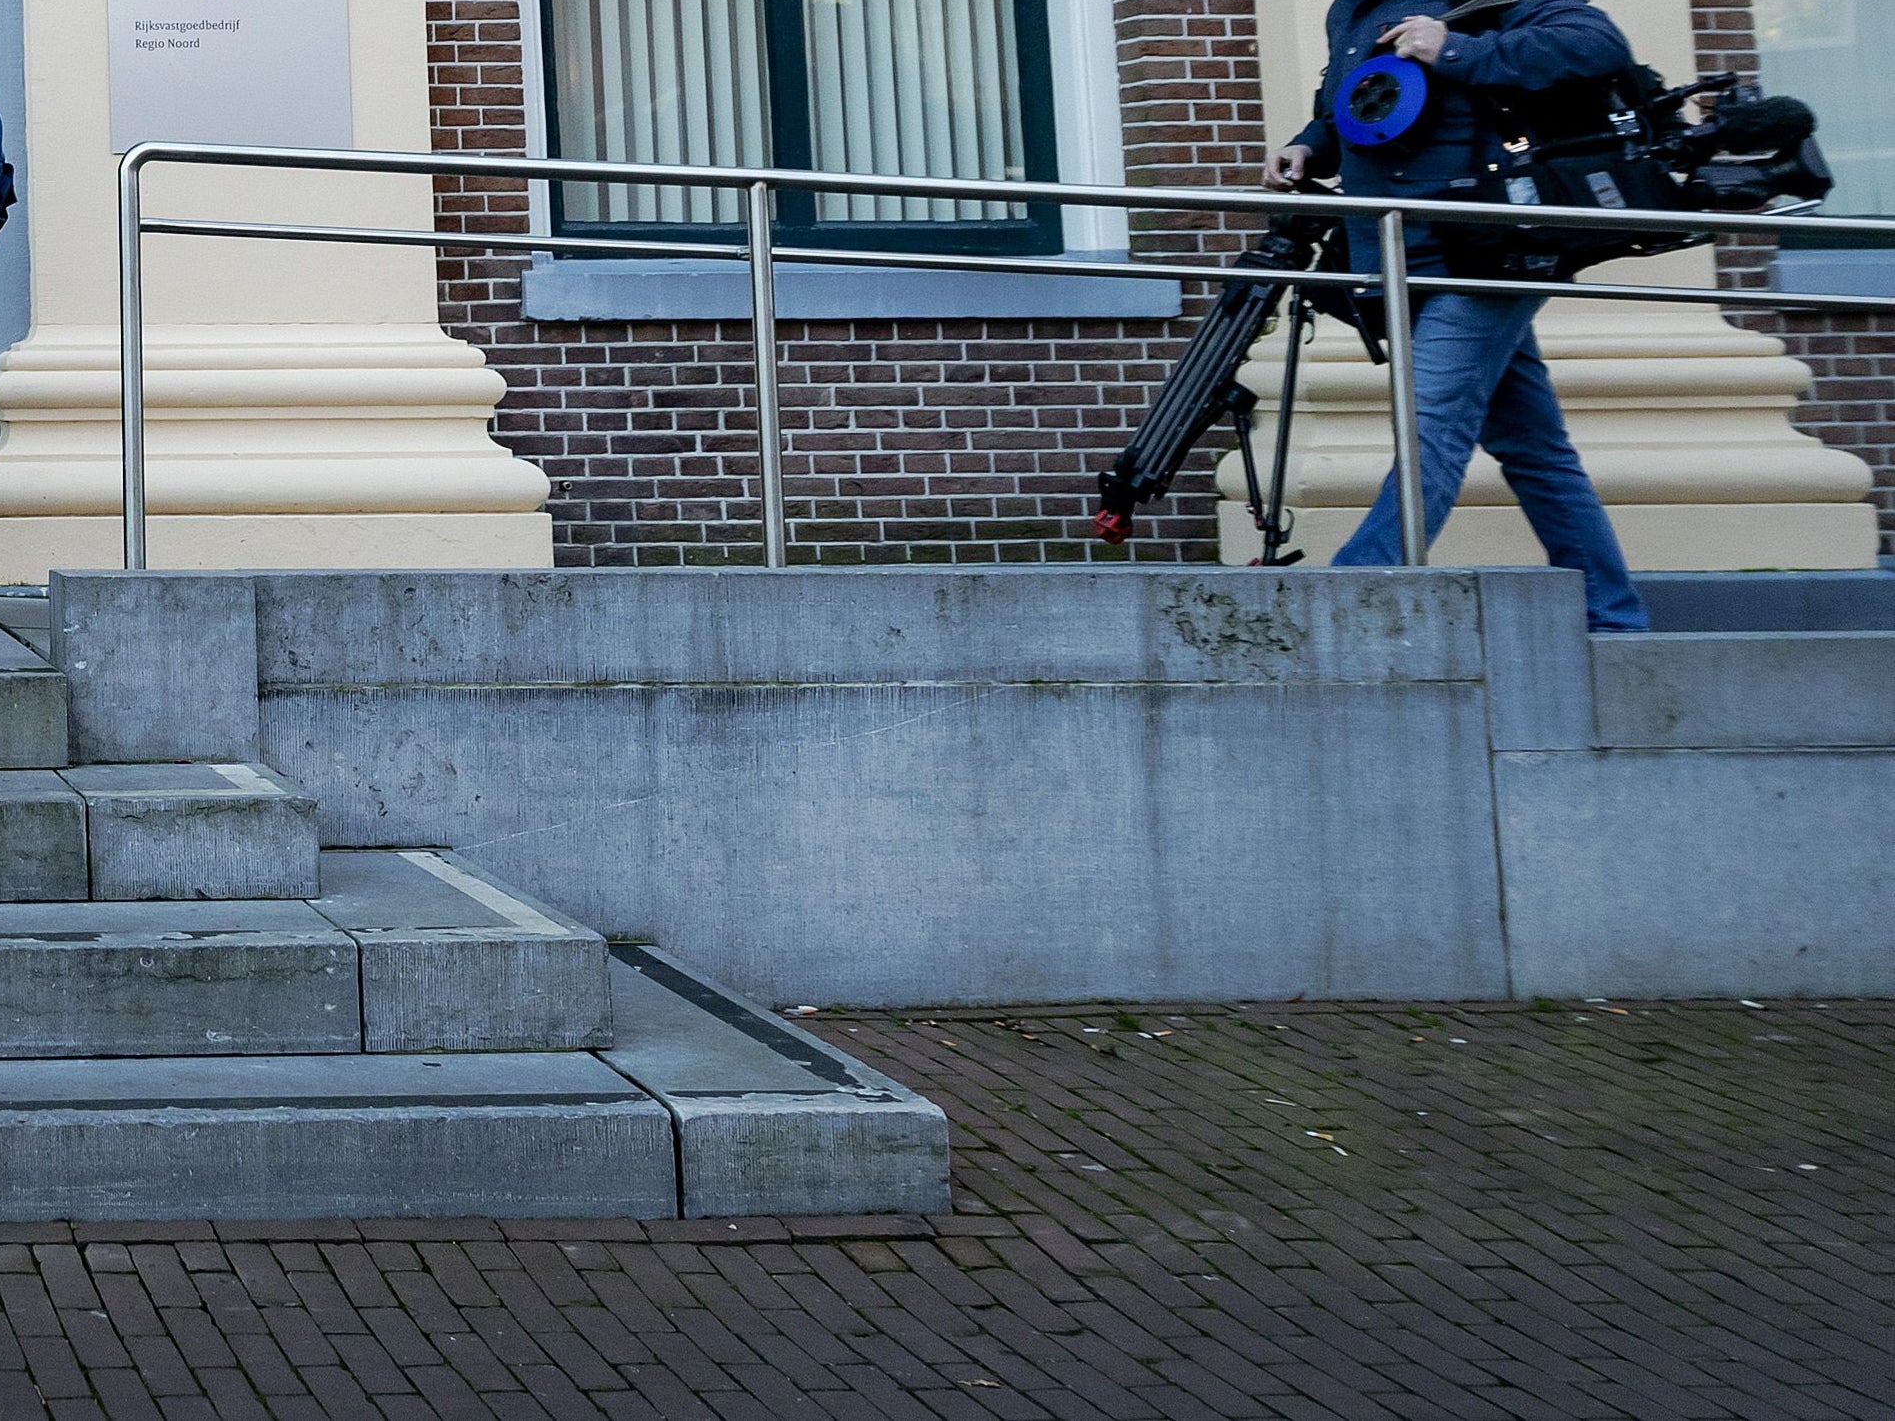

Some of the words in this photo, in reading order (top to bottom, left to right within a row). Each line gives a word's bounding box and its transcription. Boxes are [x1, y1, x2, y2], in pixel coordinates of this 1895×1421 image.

[134, 19, 241, 33] Rijksvastgoedbedrijf
[135, 38, 165, 51] Regio
[167, 38, 200, 49] Noord
